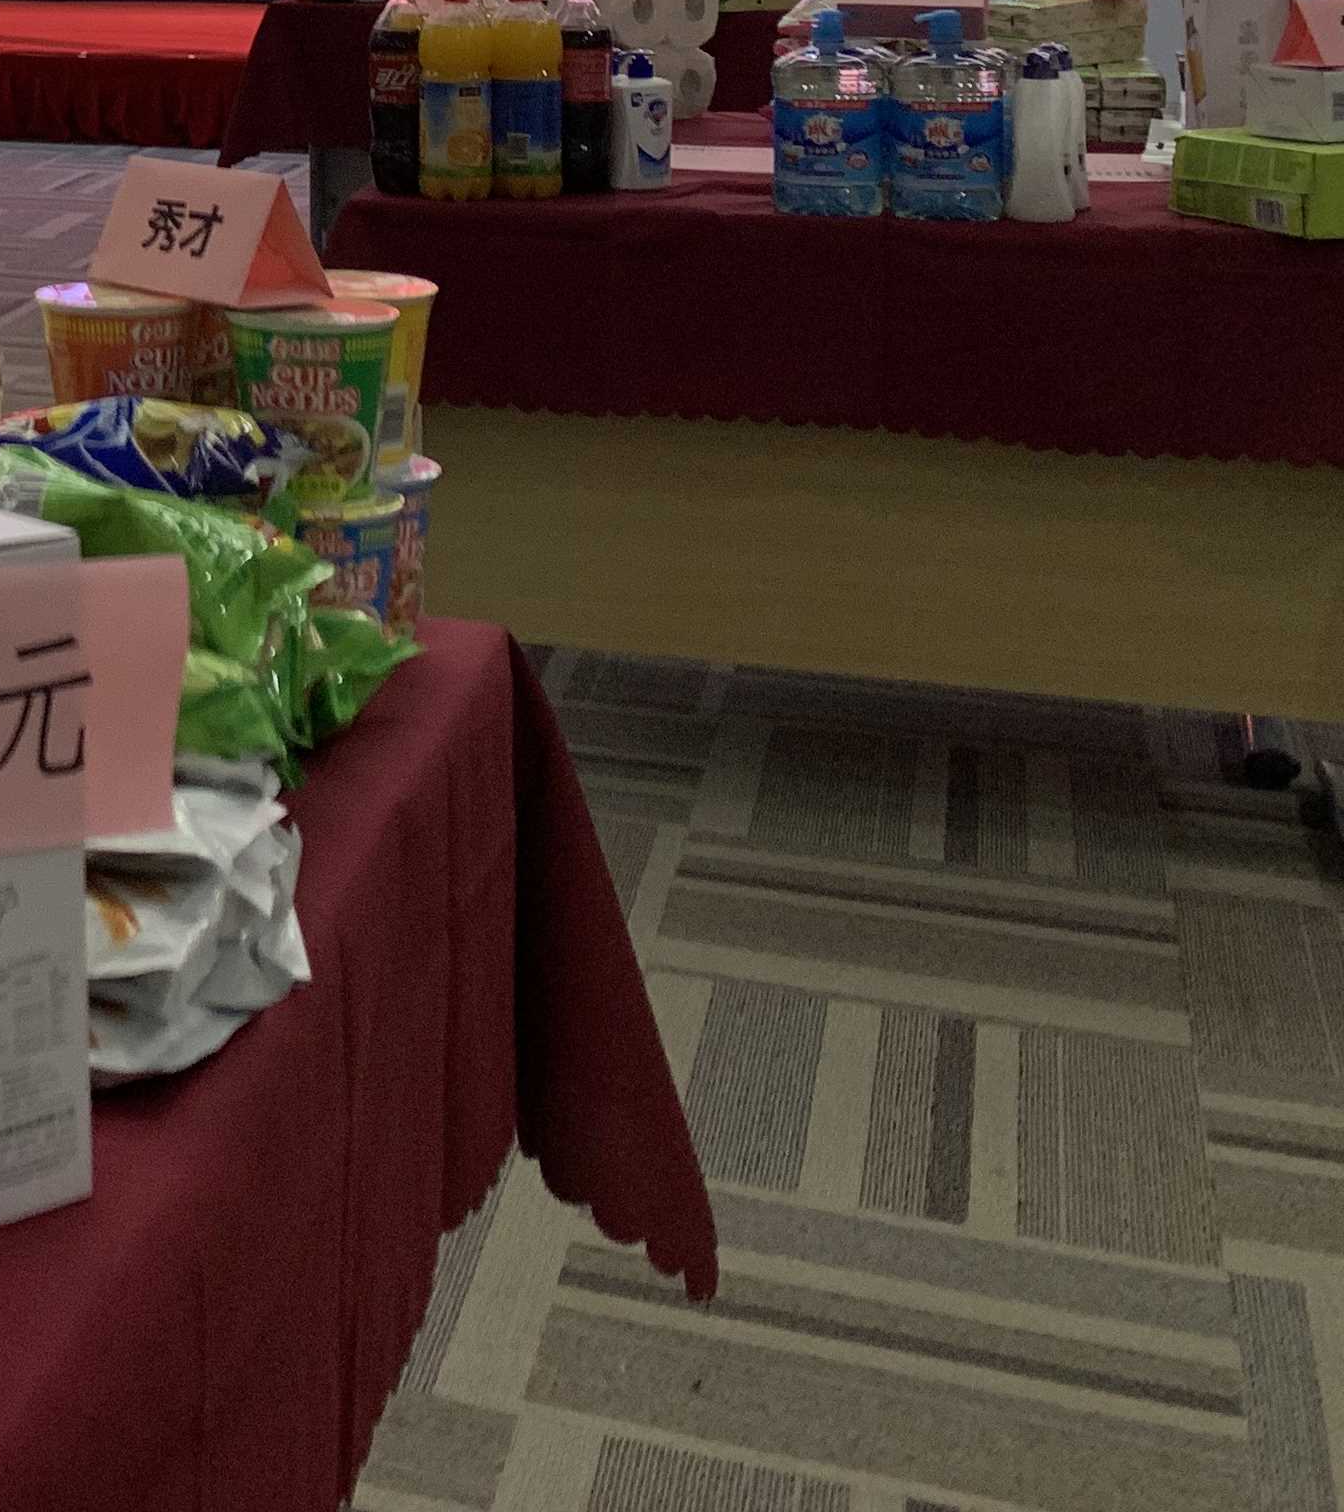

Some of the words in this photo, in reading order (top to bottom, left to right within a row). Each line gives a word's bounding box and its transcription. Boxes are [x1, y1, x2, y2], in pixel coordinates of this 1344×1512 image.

[141, 199, 224, 257] 秀才
[271, 363, 340, 390] CUP
[250, 383, 361, 415] NOODLES
